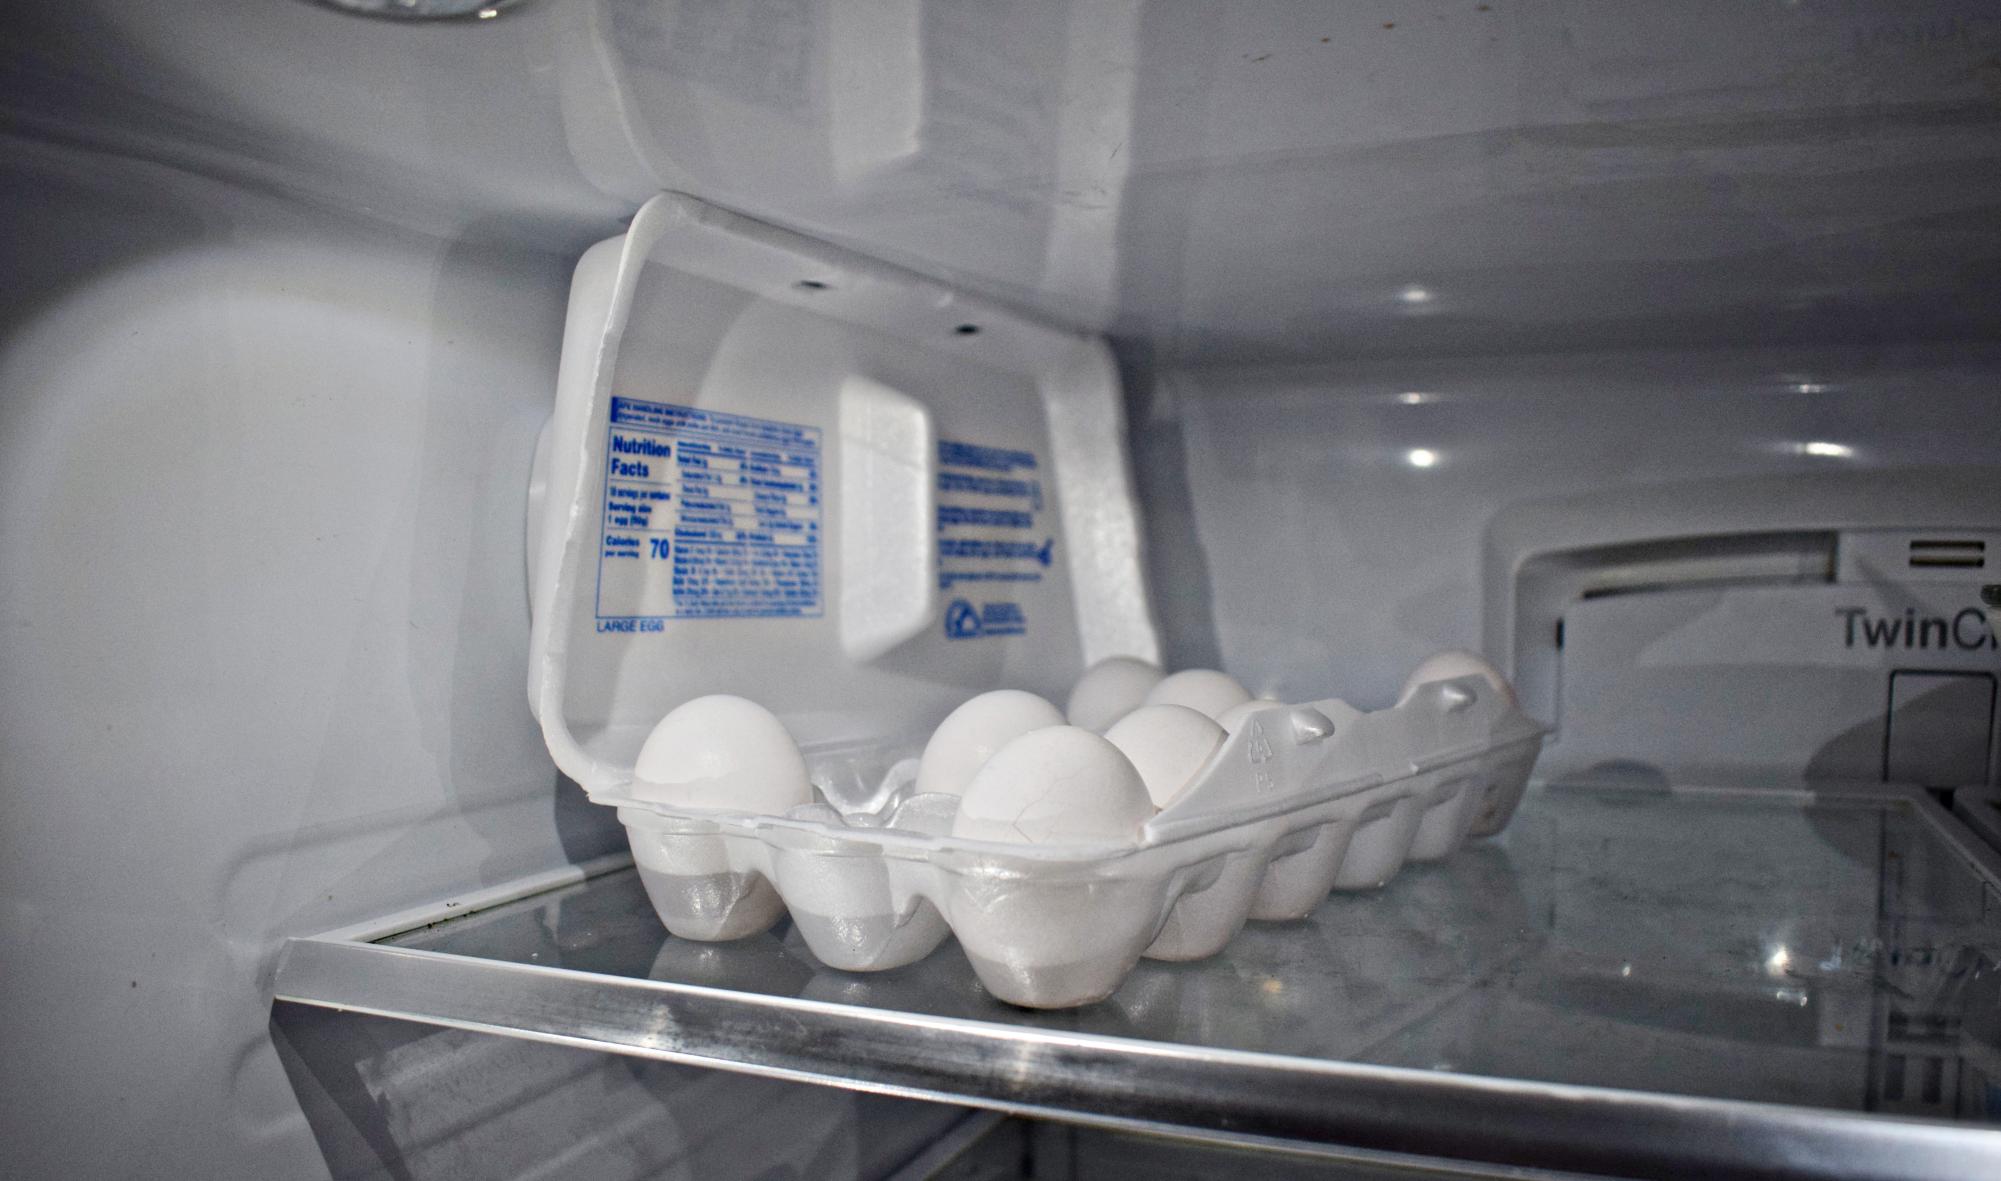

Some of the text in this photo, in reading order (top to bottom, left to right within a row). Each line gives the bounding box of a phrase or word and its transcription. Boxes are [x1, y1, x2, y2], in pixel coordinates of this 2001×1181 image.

[612, 435, 671, 458] Nutrition
[611, 458, 649, 478] Facts
[606, 536, 640, 547] Calories
[649, 538, 670, 560] 70
[597, 619, 665, 633] LARGE EGG
